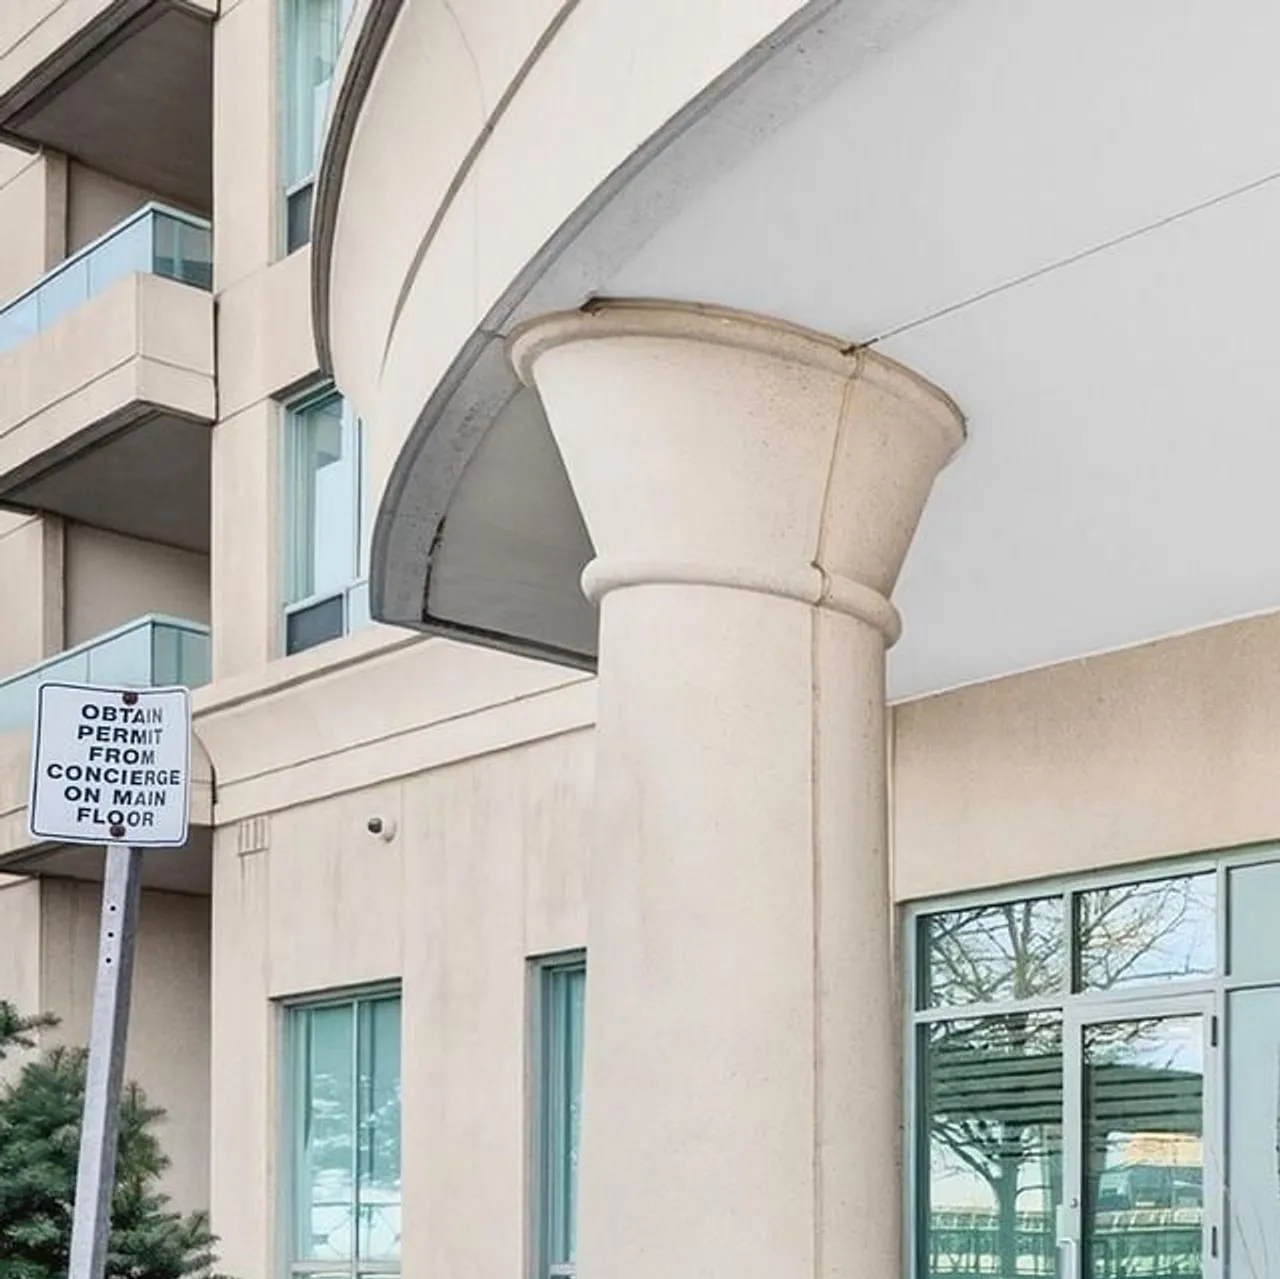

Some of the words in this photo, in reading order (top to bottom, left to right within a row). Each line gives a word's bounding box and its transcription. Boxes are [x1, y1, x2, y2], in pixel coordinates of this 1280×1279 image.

[82, 704, 162, 724] OBTAIN
[77, 725, 163, 745] PERMIT
[89, 746, 155, 765] FROM
[47, 764, 180, 785] CONCIERGE
[64, 786, 100, 803] ON
[113, 789, 166, 807] MAIN
[77, 808, 153, 827] FLOOR
